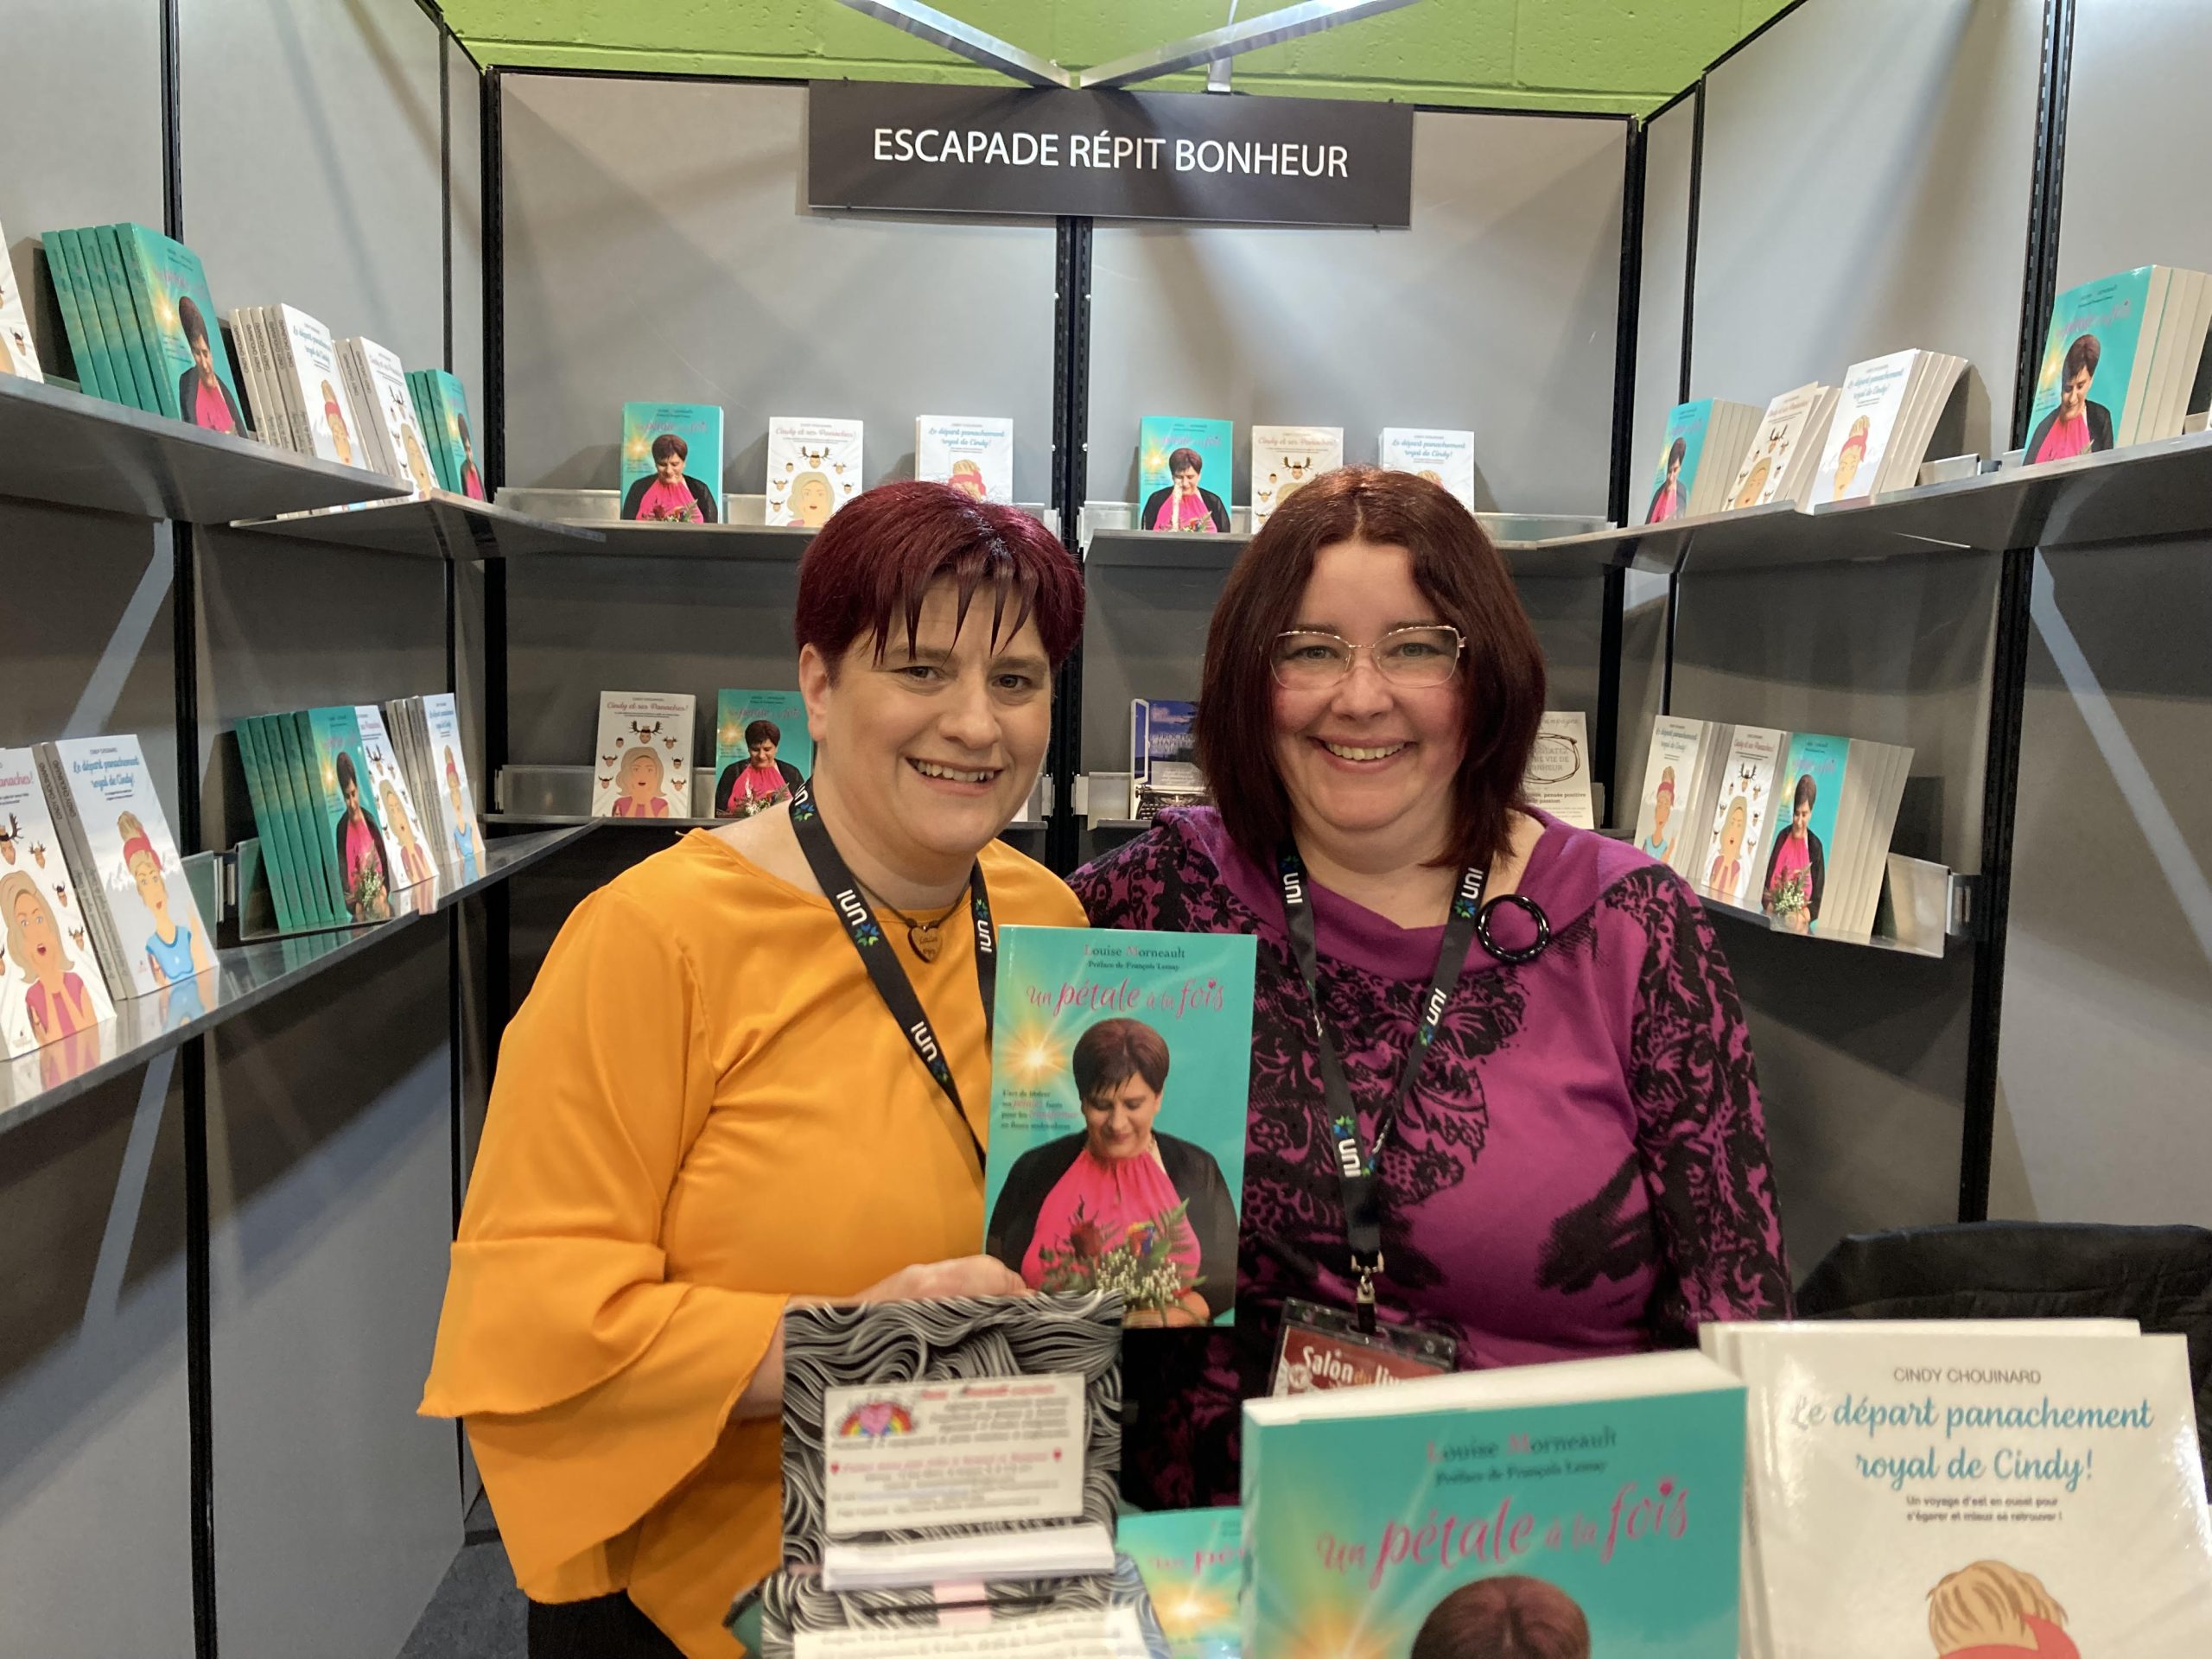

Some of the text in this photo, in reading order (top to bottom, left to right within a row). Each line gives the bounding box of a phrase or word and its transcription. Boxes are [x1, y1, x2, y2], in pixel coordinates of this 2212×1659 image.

[874, 128, 1348, 178] ESCAPADE RÉPIT BONHEUR
[1084, 944, 1185, 959] Louise Morneault
[1089, 960, 1115, 969] Préface
[1126, 961, 1155, 971] François
[1053, 977, 1141, 1018] pétale
[1161, 991, 1174, 1010] la
[1175, 977, 1224, 1019] fois
[1303, 1345, 1354, 1382] Salon
[1893, 1367, 2042, 1384] CINDY CHOUINARD
[1791, 1394, 2155, 1439] Le départ panachement
[1427, 1426, 1617, 1465] Louise Morneault
[1855, 1446, 1942, 1491] royal
[1948, 1446, 1987, 1480] de
[1906, 1496, 1921, 1506] Un
[1923, 1497, 1961, 1509] voyage
[1962, 1497, 1988, 1507] d'est
[2005, 1497, 2033, 1506] ouest
[2036, 1498, 2058, 1508] pour
[1907, 1512, 1948, 1522] s'égarer
[1951, 1512, 1961, 1521] et
[1964, 1512, 1993, 1521] mieux
[2011, 1512, 2056, 1522] retrouver
[1369, 1495, 1535, 1590] pétale
[1573, 1514, 1599, 1550] la
[1599, 1477, 1690, 1564] fois
